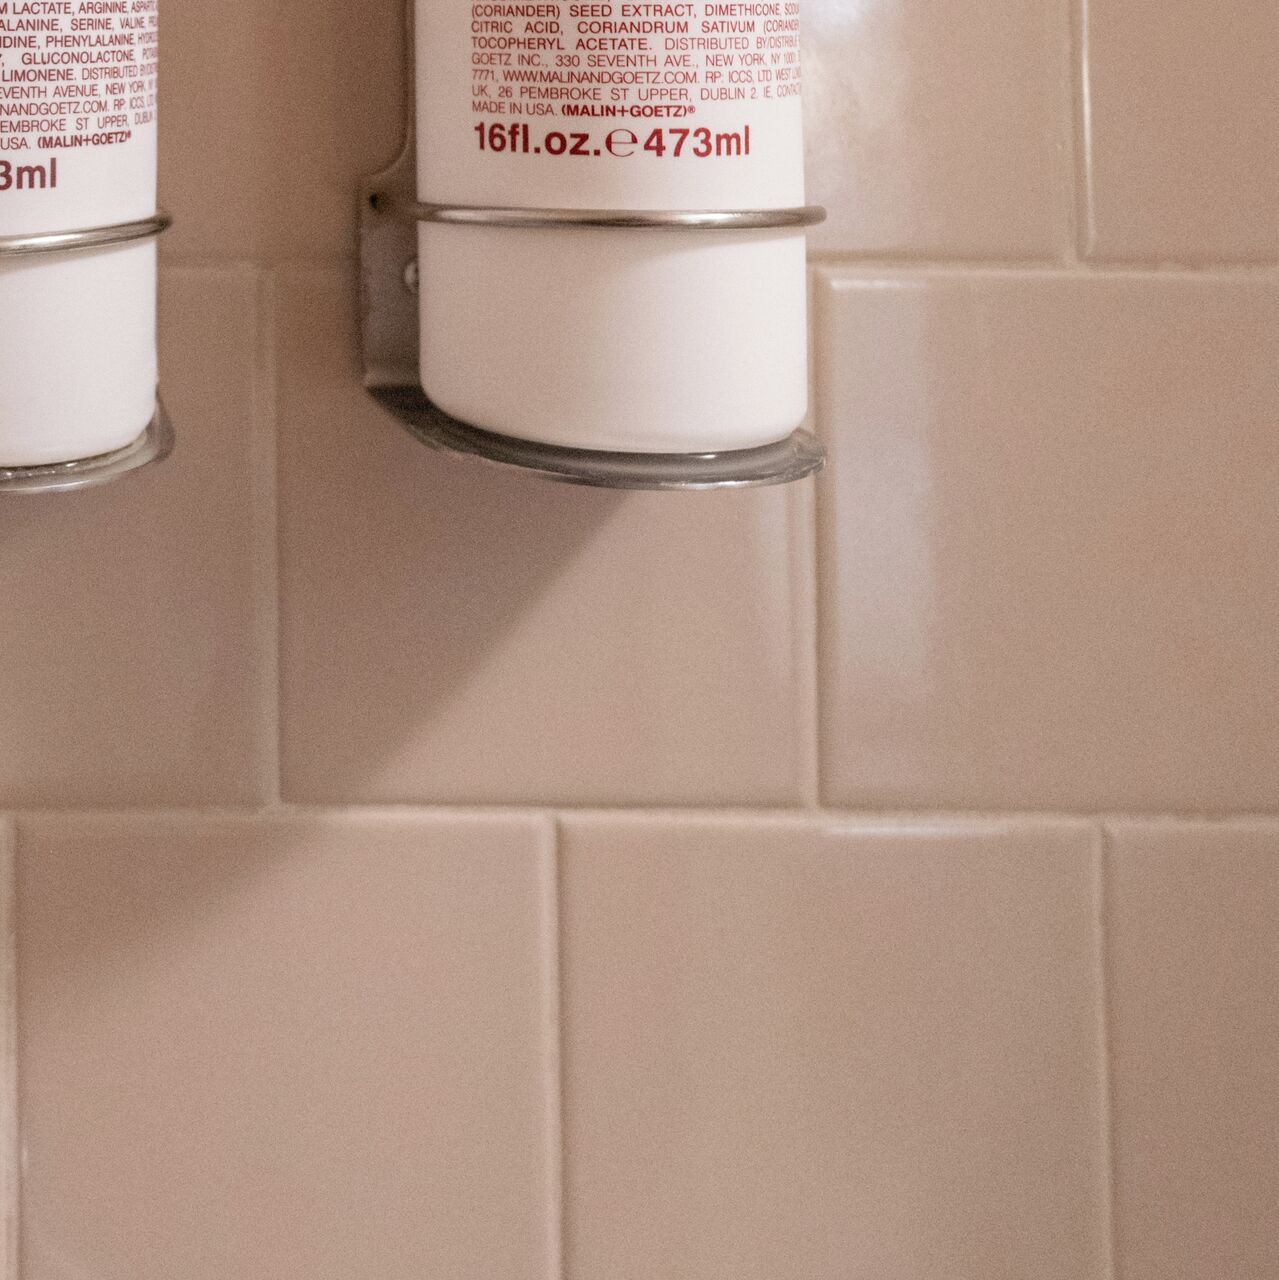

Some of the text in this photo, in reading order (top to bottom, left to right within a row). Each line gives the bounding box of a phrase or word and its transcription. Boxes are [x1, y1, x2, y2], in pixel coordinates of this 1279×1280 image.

[472, 4, 696, 20] (CORIANDER) SEED EXTRACT,
[577, 20, 755, 34] CORIANDRUM SATIVUM
[575, 37, 652, 51] ACETATE.
[0, 136, 31, 150] USA.
